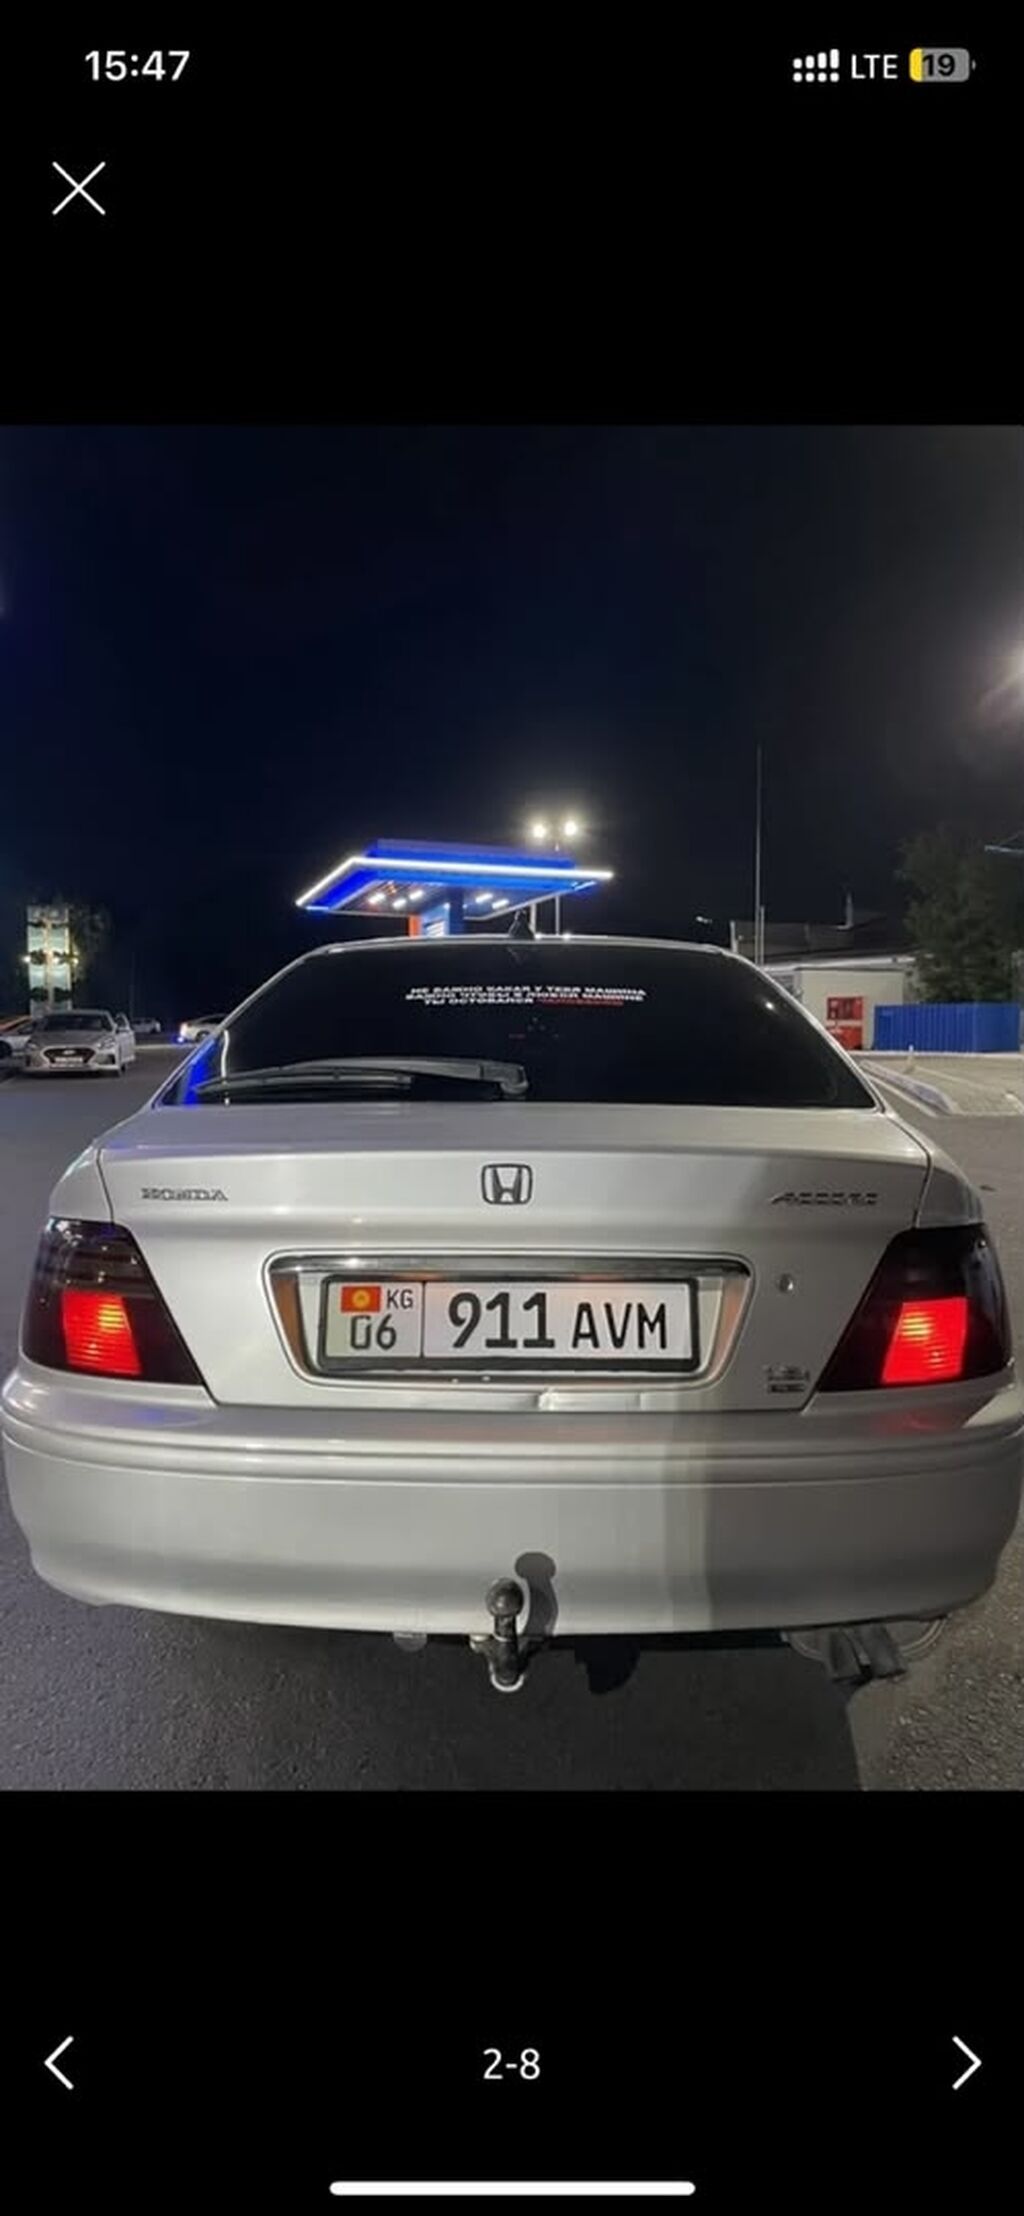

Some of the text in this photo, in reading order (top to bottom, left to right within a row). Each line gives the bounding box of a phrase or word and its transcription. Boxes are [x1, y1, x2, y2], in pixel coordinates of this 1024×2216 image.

[585, 987, 647, 996] МАШИНА
[141, 1188, 229, 1201] HONDA
[386, 1288, 414, 1310] KG
[448, 1292, 668, 1350] 911 AVM
[349, 1314, 397, 1351] 06
